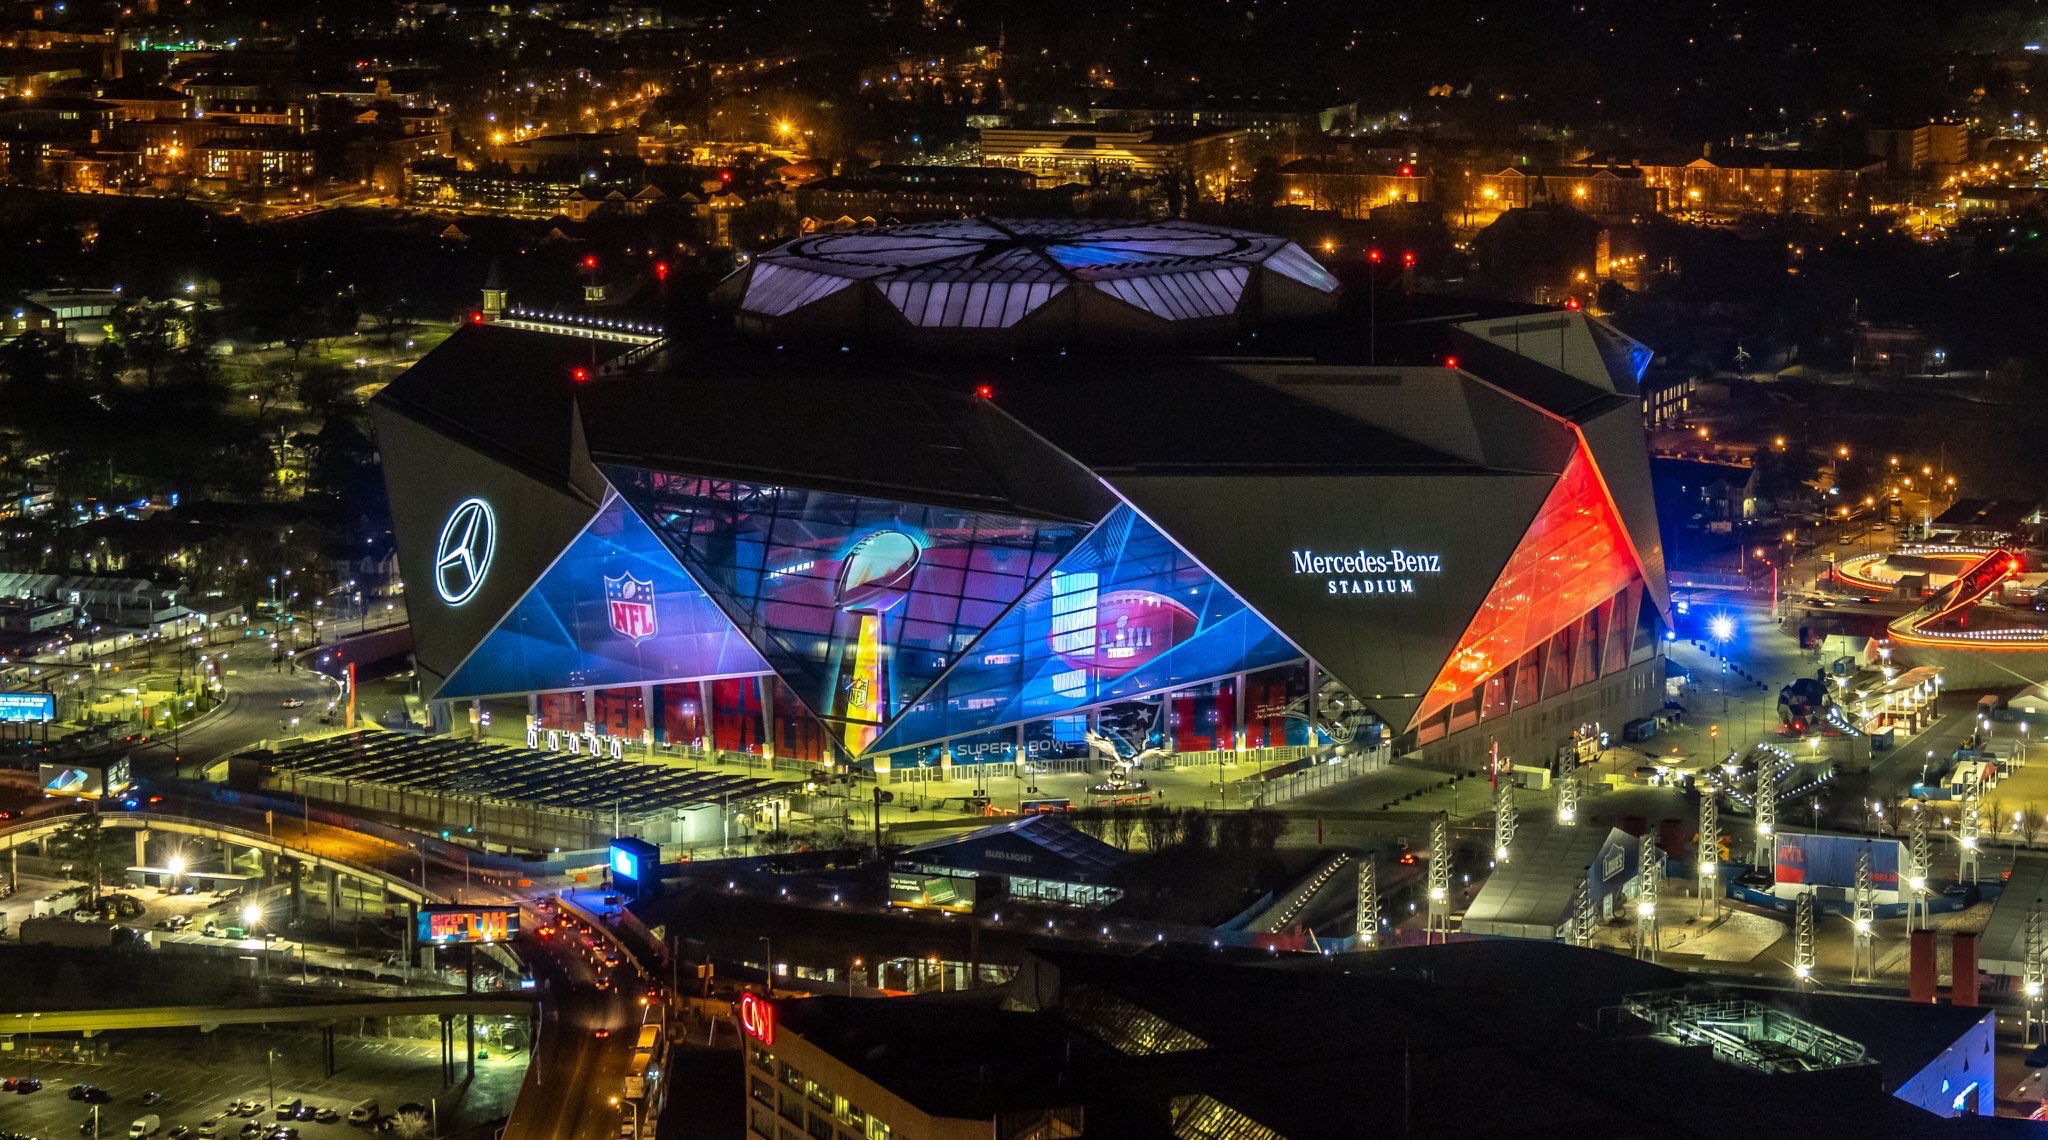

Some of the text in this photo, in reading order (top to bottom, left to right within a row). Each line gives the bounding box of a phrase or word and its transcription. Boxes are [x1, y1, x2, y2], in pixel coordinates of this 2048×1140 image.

[1292, 550, 1441, 574] Mercedes-Benz
[1328, 579, 1414, 594] STADIUM
[612, 602, 653, 638] NFL
[849, 688, 866, 704] NFL
[957, 740, 1075, 756] SUPER BOWL
[985, 849, 1033, 862] BUD LIGHT
[431, 911, 508, 940] SUPER LIII
[431, 925, 460, 936] BOWL
[742, 992, 773, 1046] CNN
